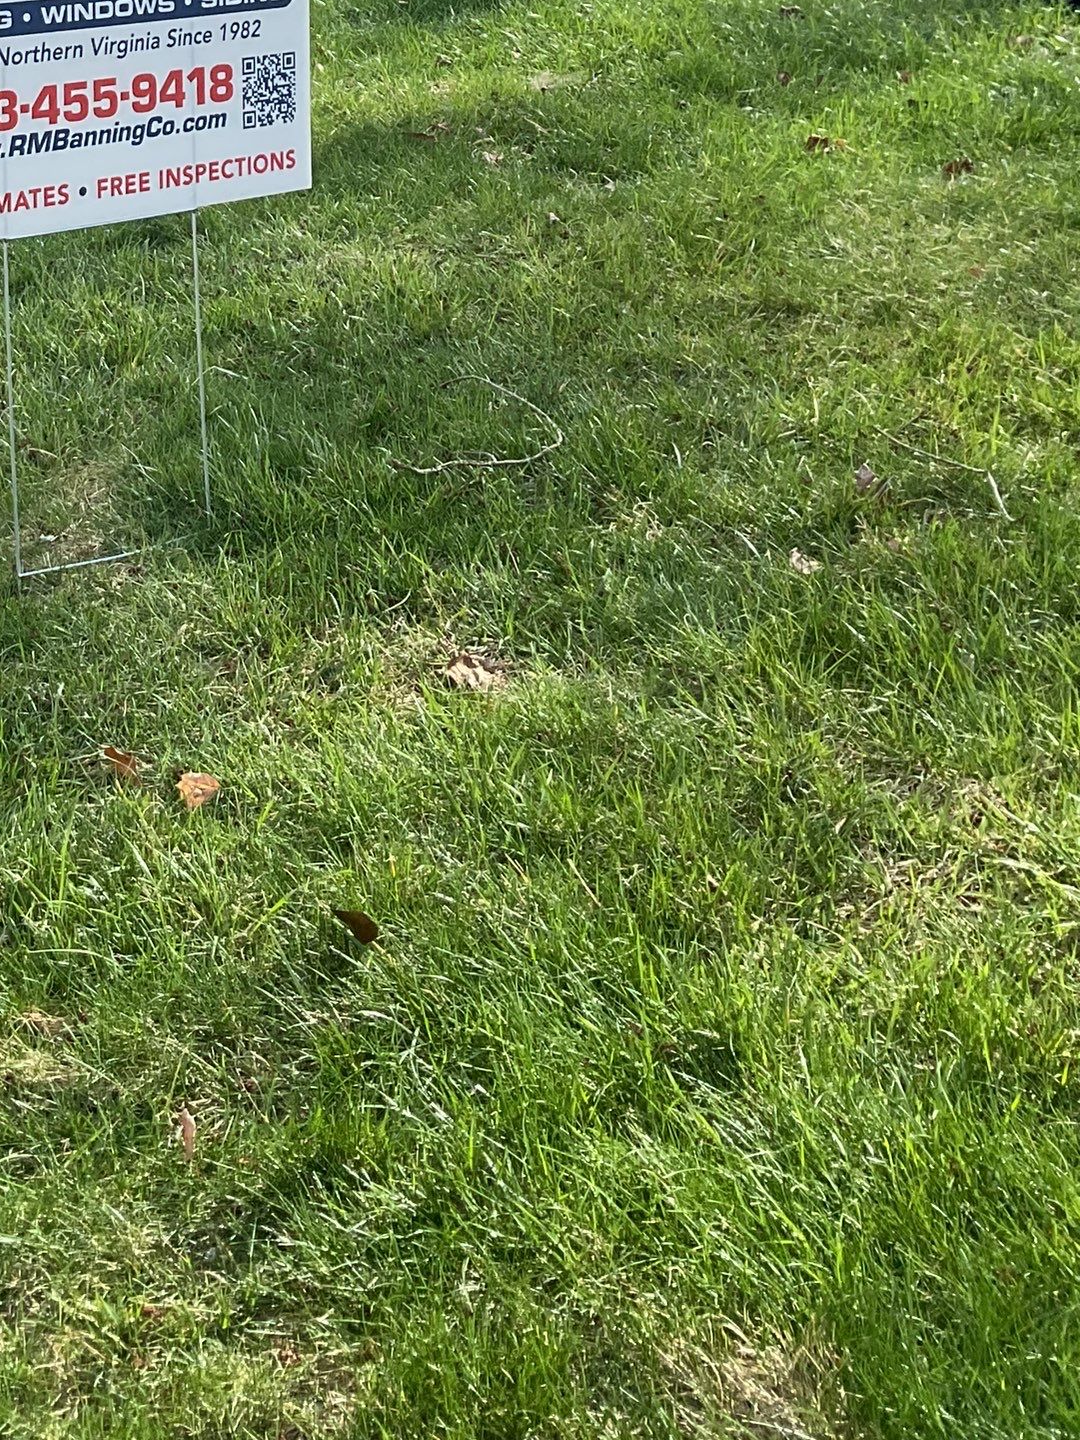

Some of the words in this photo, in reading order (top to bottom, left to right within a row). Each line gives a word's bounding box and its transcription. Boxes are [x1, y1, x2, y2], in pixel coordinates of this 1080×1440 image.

[91, 32, 160, 59] Virginia
[167, 28, 212, 47] Since
[220, 20, 261, 41] 1982
[98, 172, 150, 198] FREE
[160, 150, 295, 189] INSPECTIONS
